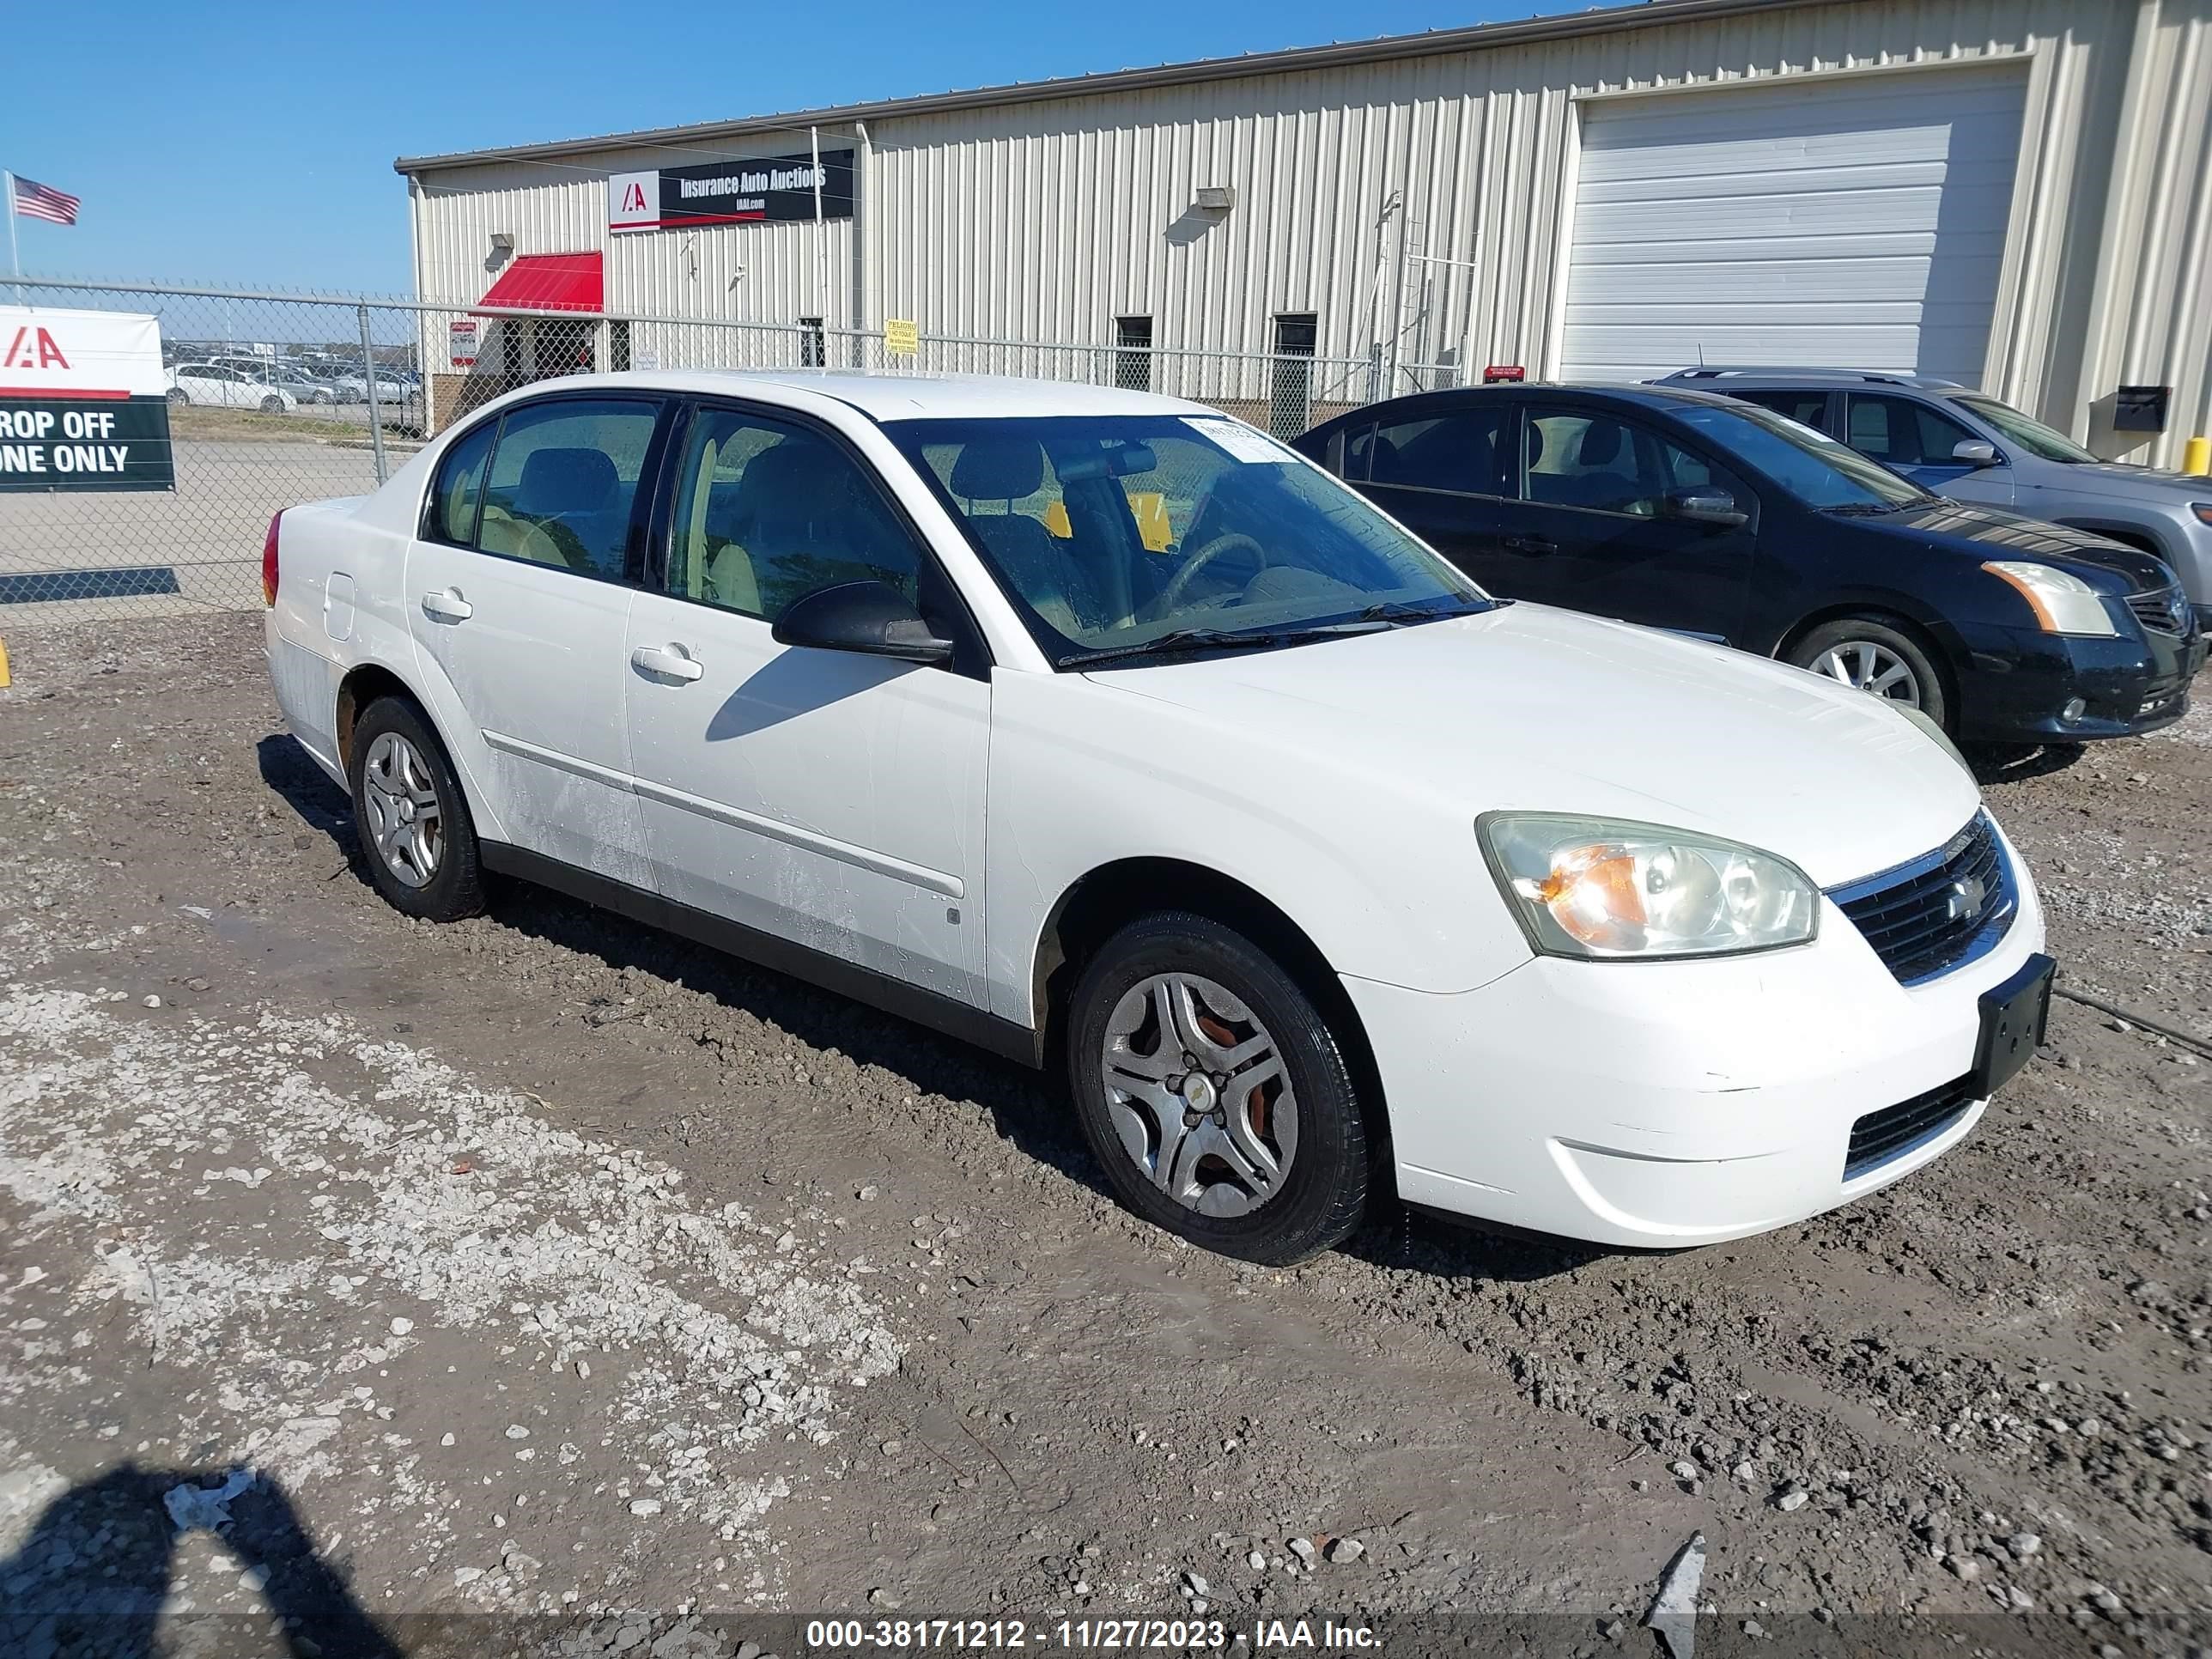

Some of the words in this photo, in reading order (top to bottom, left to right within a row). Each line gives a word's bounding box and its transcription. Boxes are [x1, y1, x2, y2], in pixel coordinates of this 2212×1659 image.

[680, 177, 738, 199] Insurance
[740, 171, 769, 192] Auto
[63, 411, 116, 439] OFF
[0, 445, 47, 472] NE
[53, 445, 129, 472] ONLY
